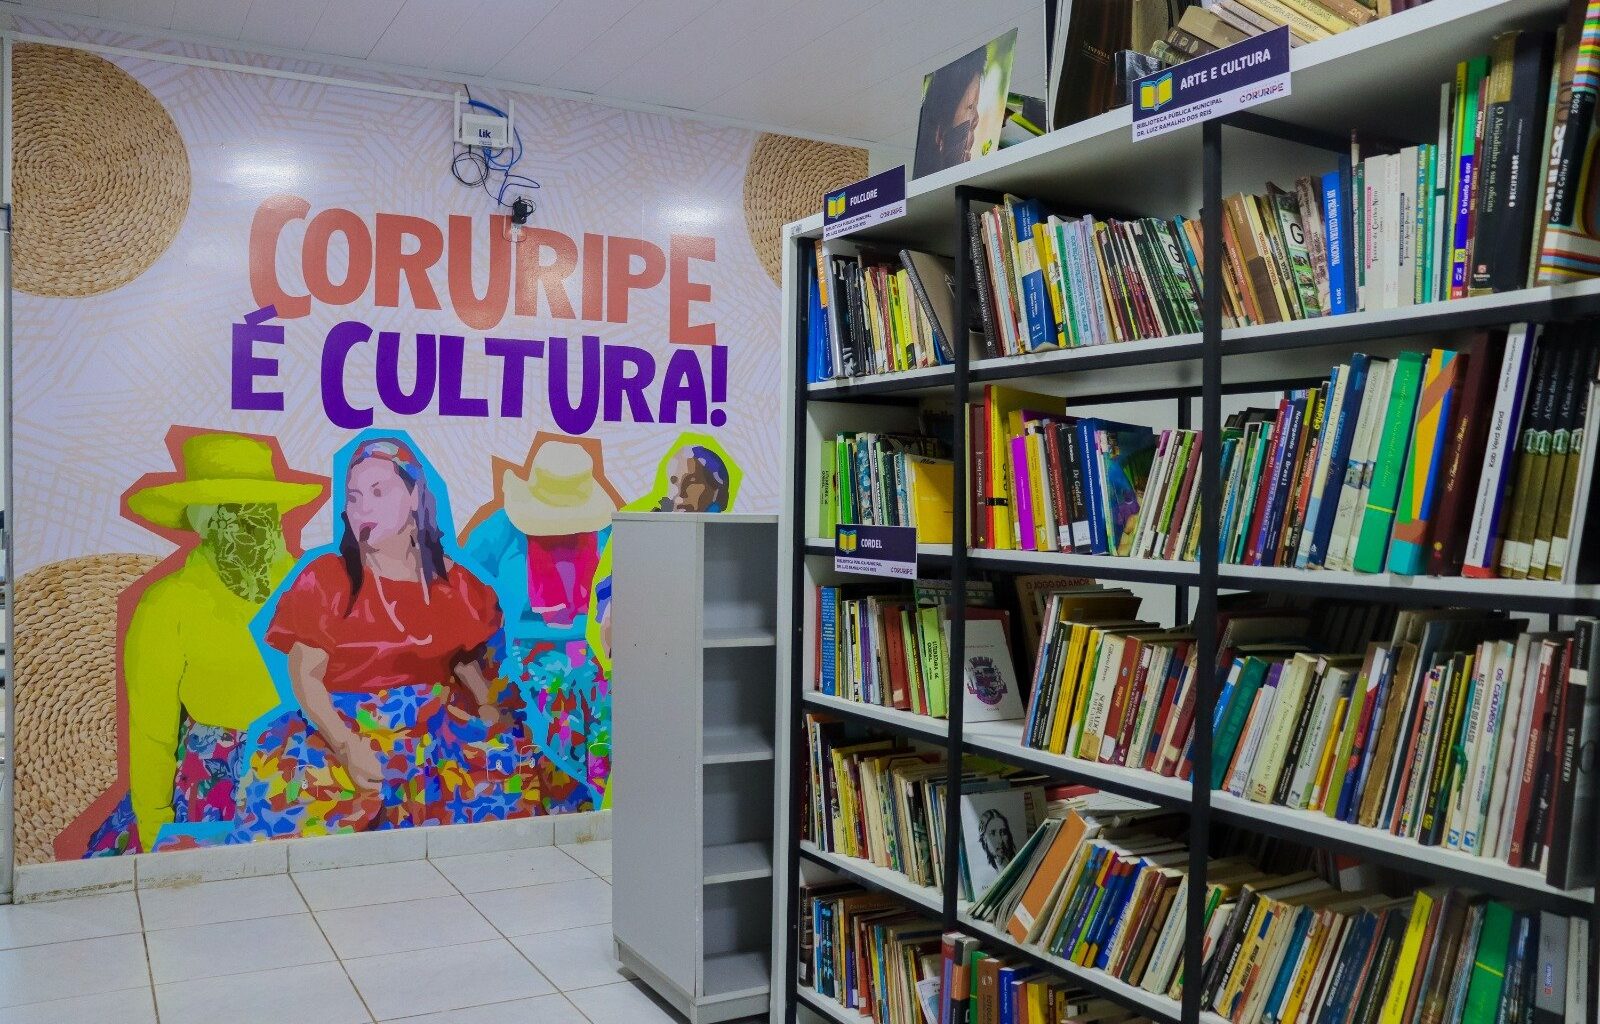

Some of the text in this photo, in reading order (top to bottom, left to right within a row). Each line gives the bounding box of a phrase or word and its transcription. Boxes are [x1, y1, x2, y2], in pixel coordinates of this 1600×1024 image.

[1180, 48, 1271, 91] ARTE E CULTURA
[1239, 82, 1284, 103] CORURIPE
[1136, 98, 1223, 130] BIBLIOTECA PÚBLICA MUNICIPAL
[1495, 106, 1504, 114] O
[1570, 93, 1582, 114] 2006
[1146, 126, 1158, 135] LUIZ
[1159, 117, 1186, 131] RAMALHO
[1187, 113, 1199, 122] DOS
[1200, 109, 1212, 119] REIS
[1493, 116, 1503, 162] Aleijadinho
[1463, 174, 1469, 183] da
[1558, 158, 1570, 186] Cultura
[849, 188, 878, 206] FOLCLORE
[1461, 184, 1469, 206] triunfo
[1486, 186, 1496, 212] oficina
[1553, 188, 1564, 201] da
[1550, 201, 1563, 222] Copa
[1329, 218, 1338, 239] CULTURA
[1330, 240, 1340, 266] NACIONAL
[249, 195, 717, 346] CORURIPE
[231, 304, 729, 436] É CULTURA!
[1535, 378, 1543, 392] das
[1547, 380, 1556, 393] das
[1531, 392, 1541, 410] Casa
[1544, 393, 1554, 412] Casa
[1561, 391, 1571, 410] Casa
[1314, 398, 1326, 430] LAMPIÃO
[1494, 410, 1505, 431] Band
[1288, 410, 1301, 449] Navegando
[1490, 431, 1501, 450] Verd
[1280, 460, 1291, 486] Brasil
[1074, 480, 1083, 506] Godard
[860, 538, 883, 549] CORDEL
[1068, 578, 1089, 586] AMOR
